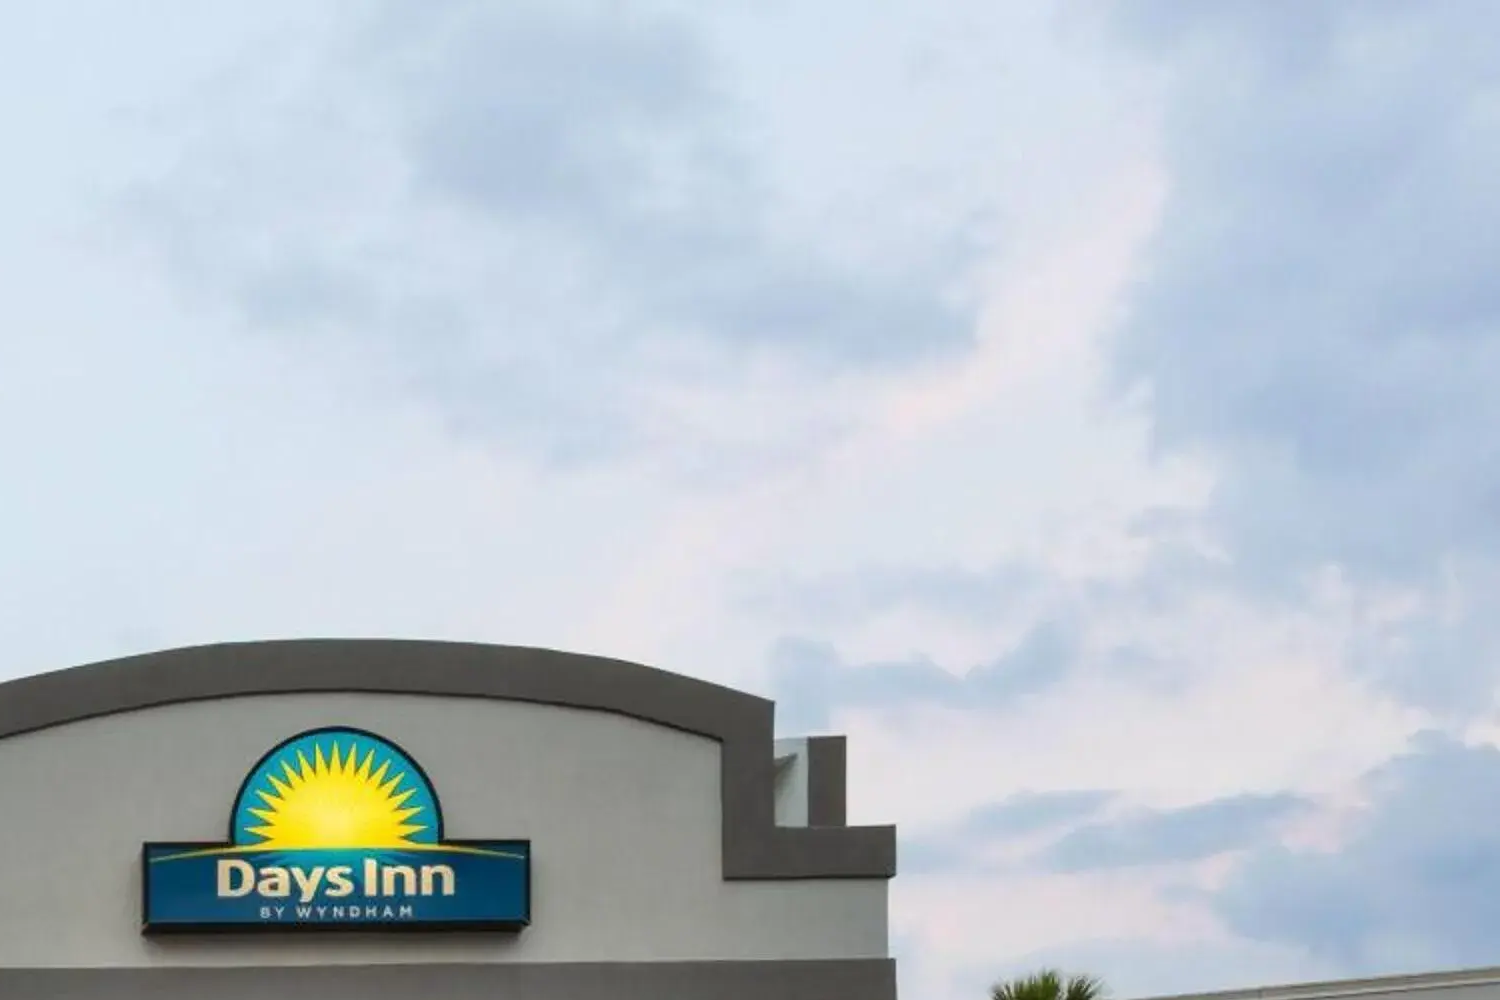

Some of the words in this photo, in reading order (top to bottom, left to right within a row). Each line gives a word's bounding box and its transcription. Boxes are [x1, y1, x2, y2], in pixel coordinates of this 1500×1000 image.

[217, 859, 355, 902] Days
[363, 858, 455, 897] Inn
[260, 906, 285, 919] BY
[296, 906, 414, 918] WYNDHAM
